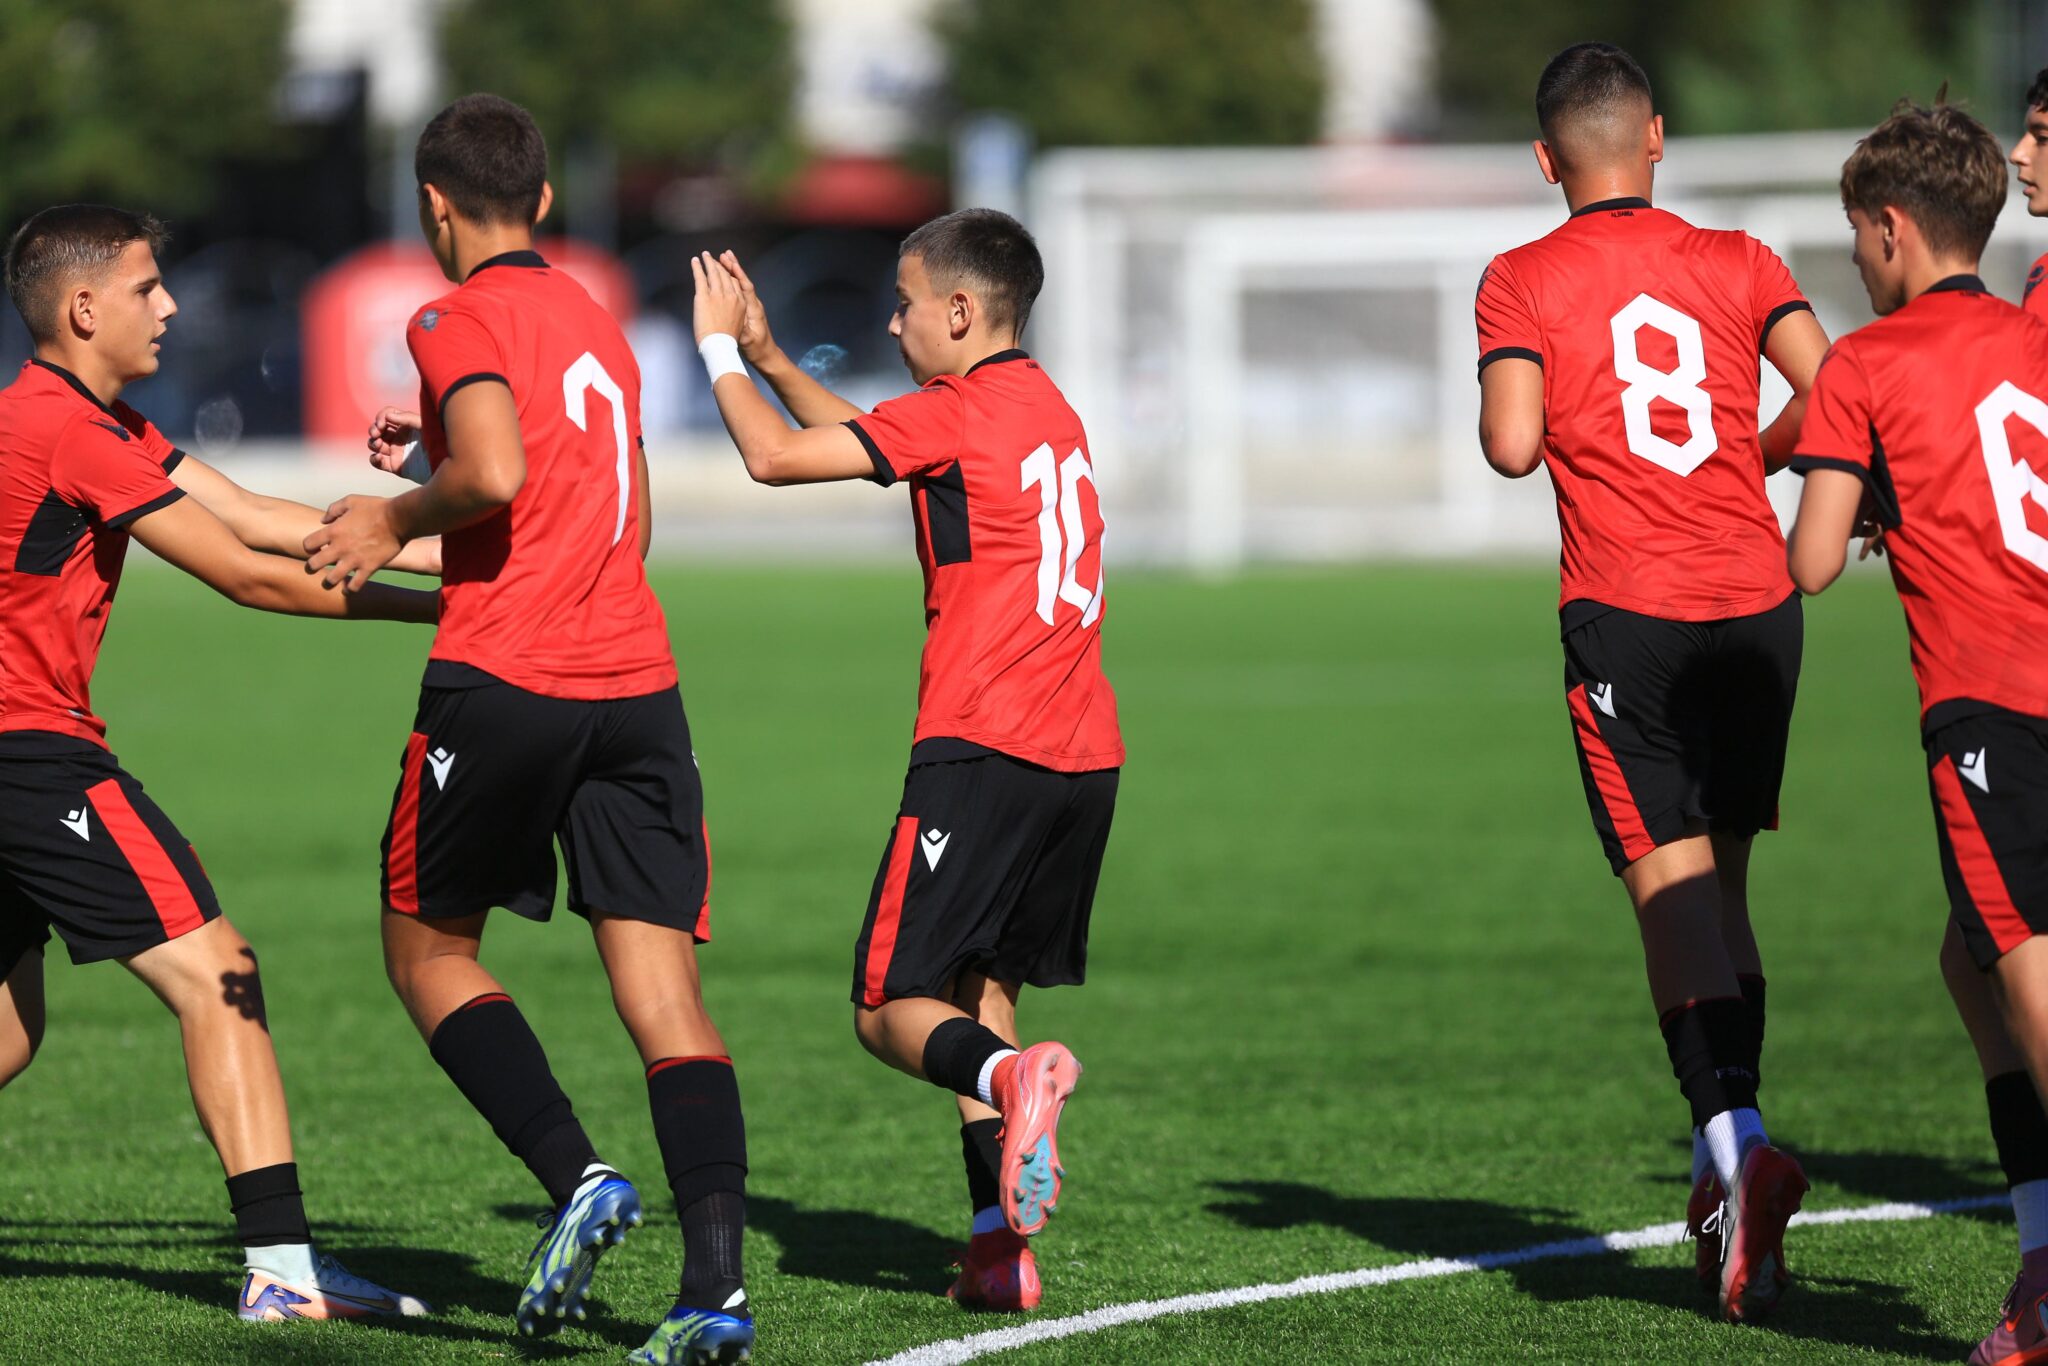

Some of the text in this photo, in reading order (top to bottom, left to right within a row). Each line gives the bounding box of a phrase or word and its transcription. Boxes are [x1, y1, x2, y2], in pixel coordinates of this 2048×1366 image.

[563, 352, 625, 545] 7
[1610, 293, 1718, 477] 8
[1975, 381, 2048, 573] 6
[1020, 442, 1107, 629] 10
